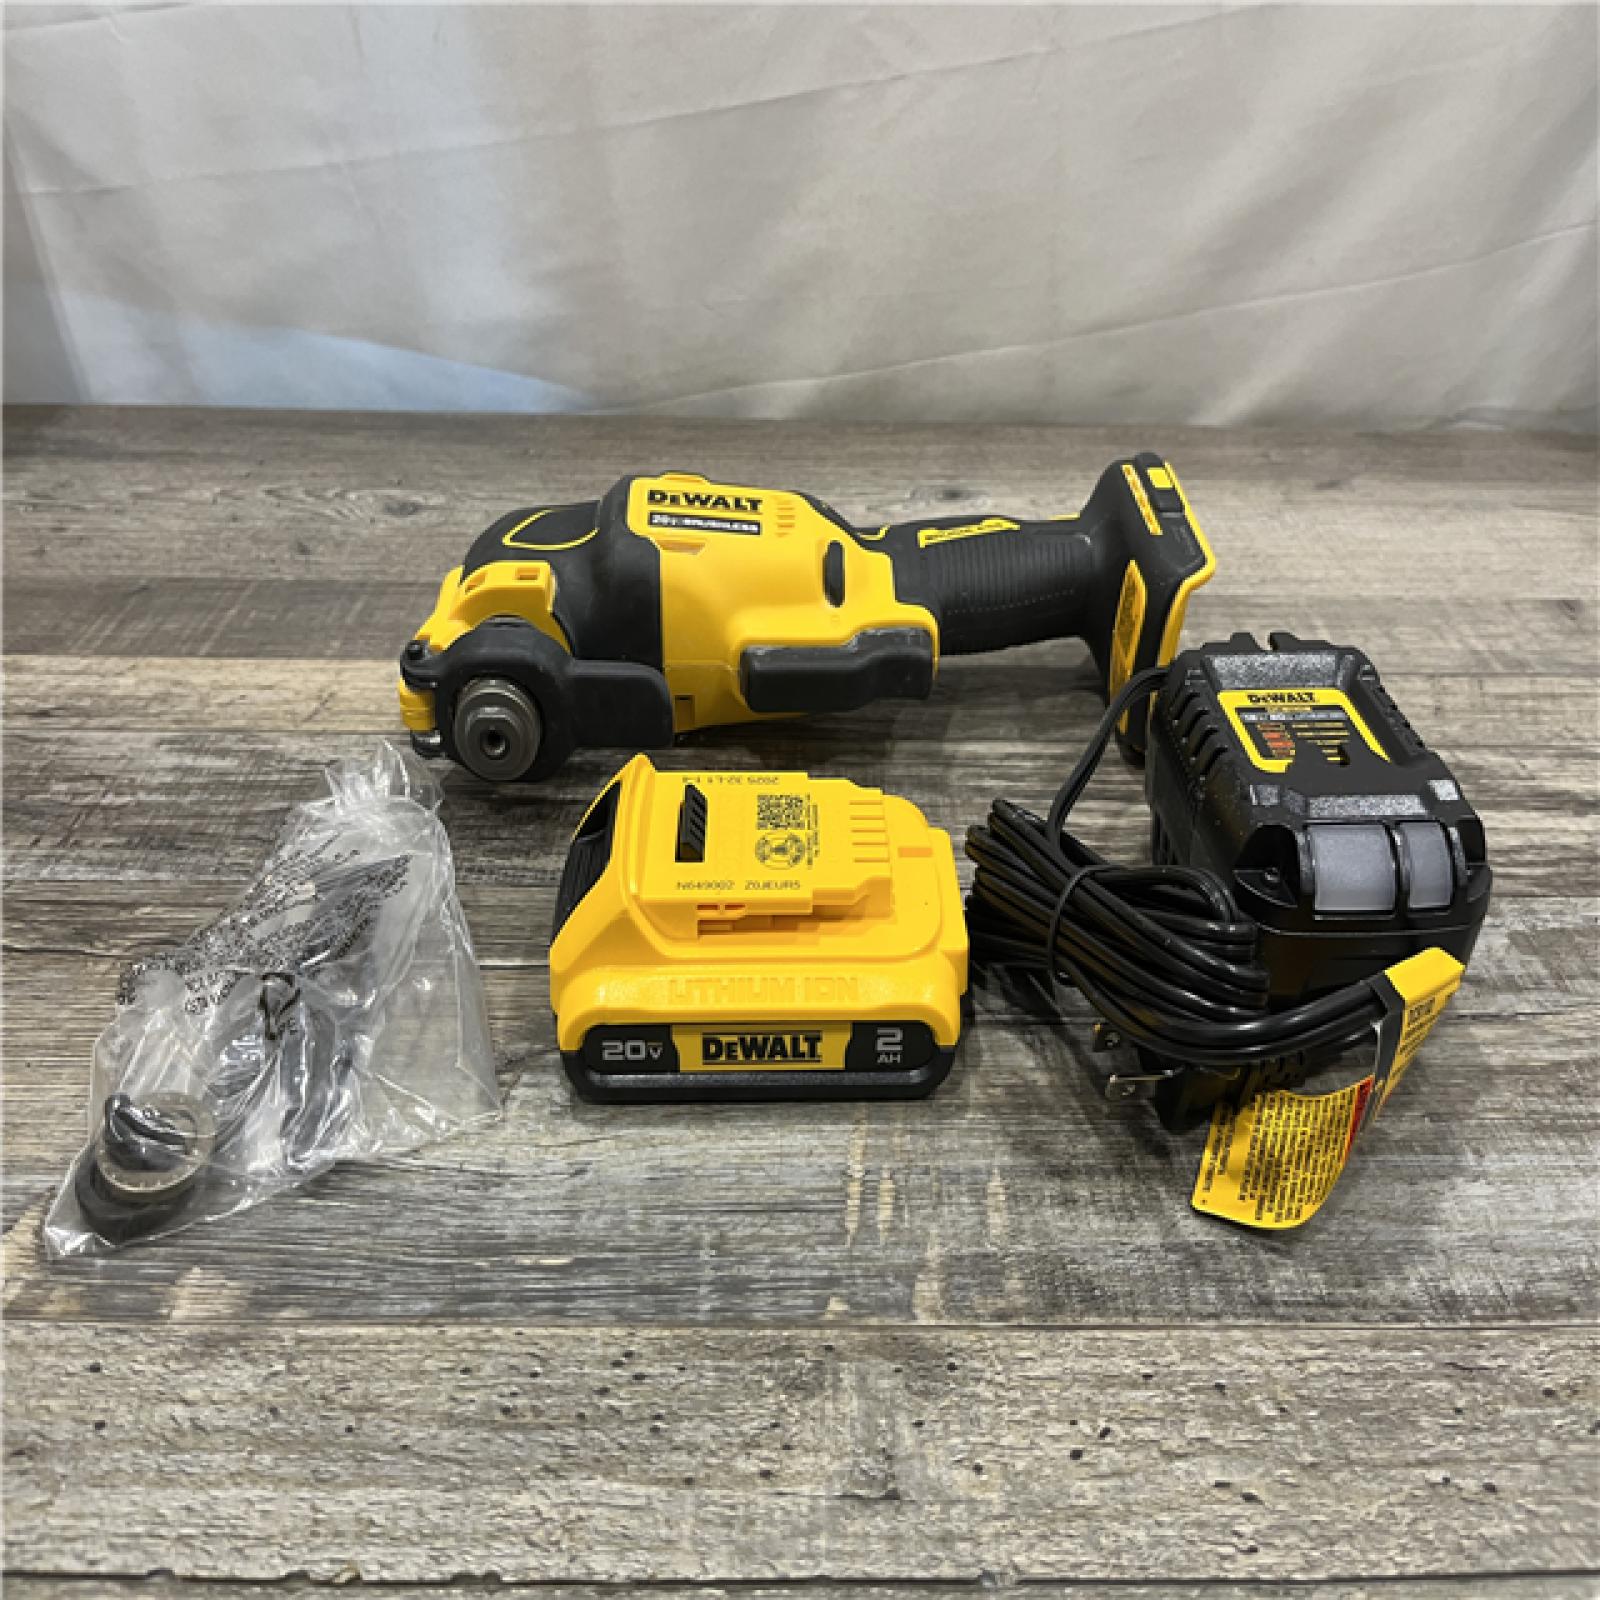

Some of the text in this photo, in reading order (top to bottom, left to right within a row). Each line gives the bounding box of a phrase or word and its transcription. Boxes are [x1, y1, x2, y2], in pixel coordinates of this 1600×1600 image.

[648, 489, 763, 511] DEWALT
[669, 976, 859, 1004] LITHIUM ION
[703, 1035, 822, 1060] DEWALT
[876, 1028, 904, 1051] 2
